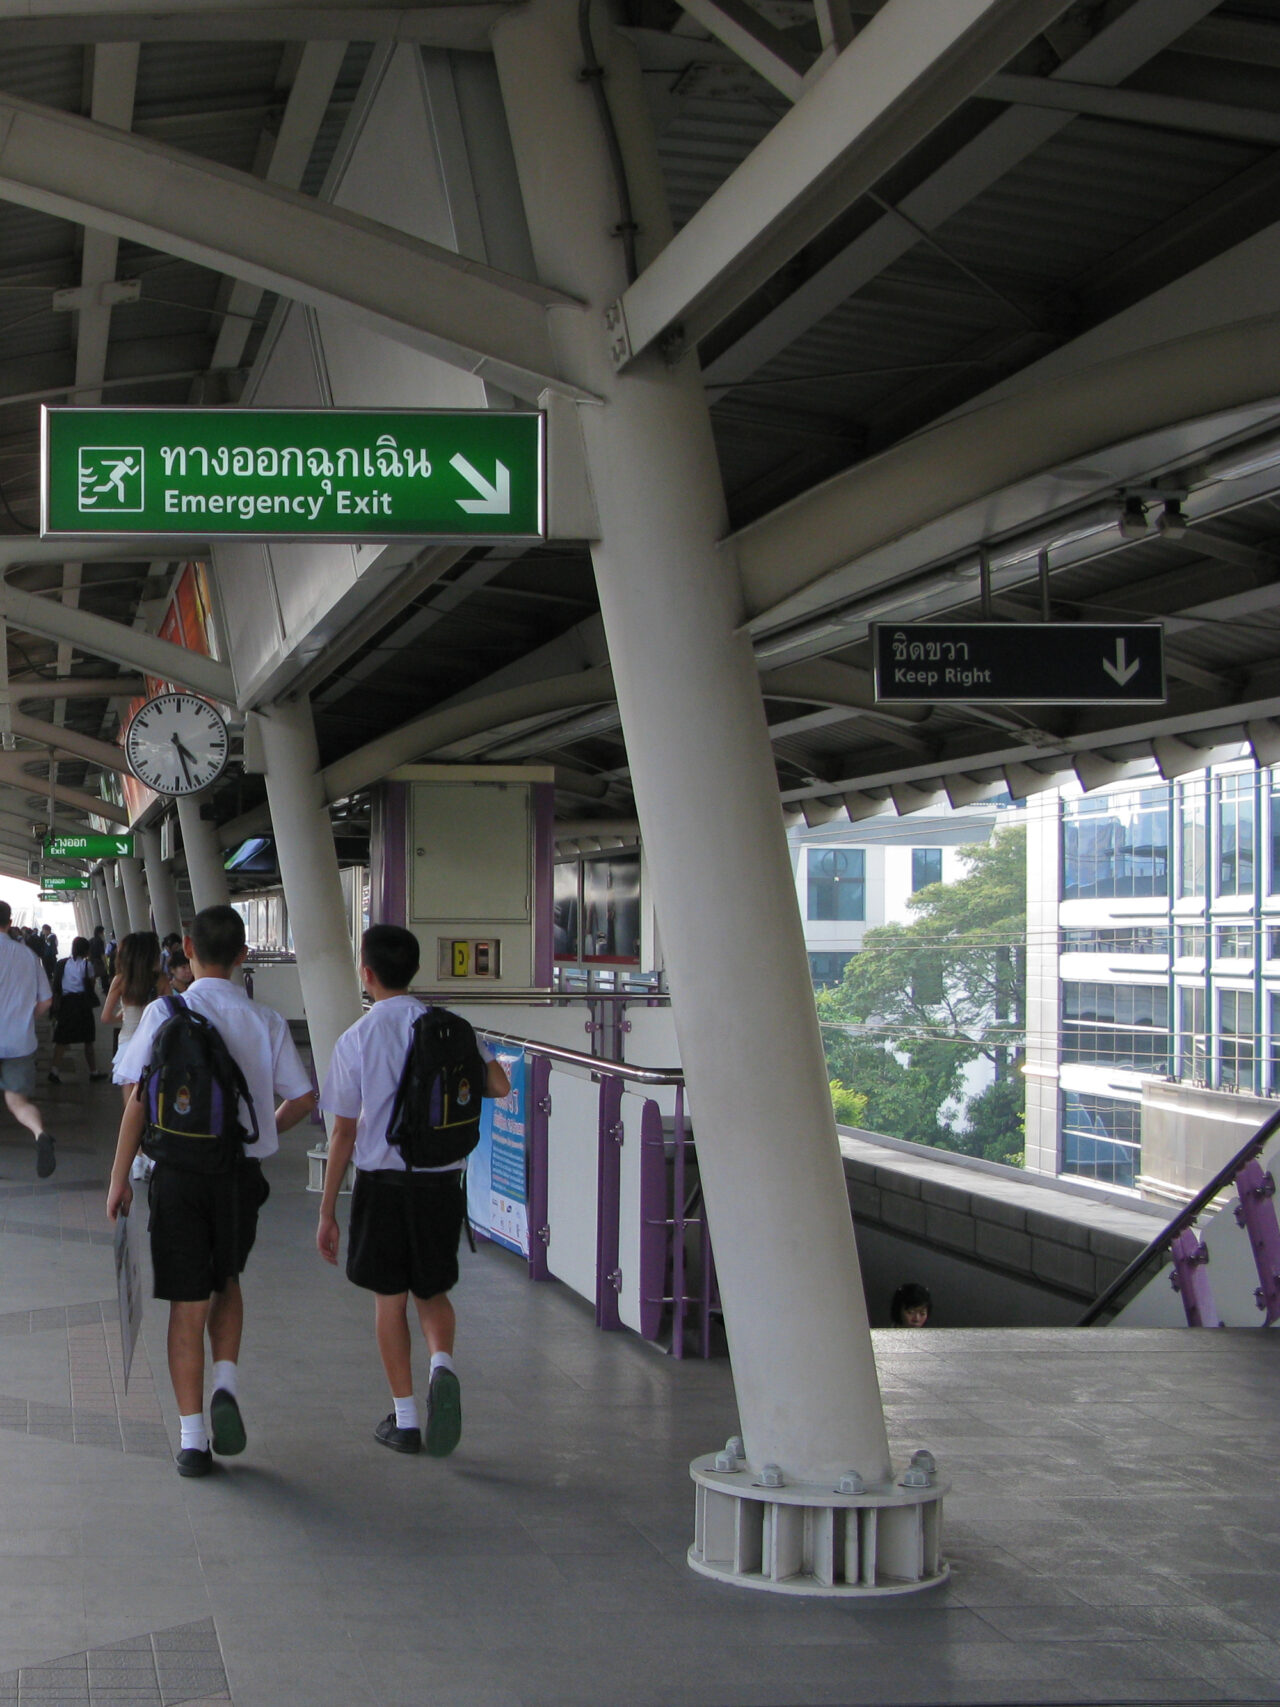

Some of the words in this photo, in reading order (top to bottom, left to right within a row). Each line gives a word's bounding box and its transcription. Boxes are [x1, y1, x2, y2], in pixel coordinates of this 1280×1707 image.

[160, 434, 432, 496] ทางออกฉุกเฉิน
[164, 489, 324, 520] Emergency
[336, 490, 393, 515] Exit
[892, 632, 968, 660] ชิดขวา
[894, 668, 938, 686] Keep
[945, 667, 992, 687] Right
[50, 847, 66, 855] Exit
[51, 838, 87, 847] างออก
